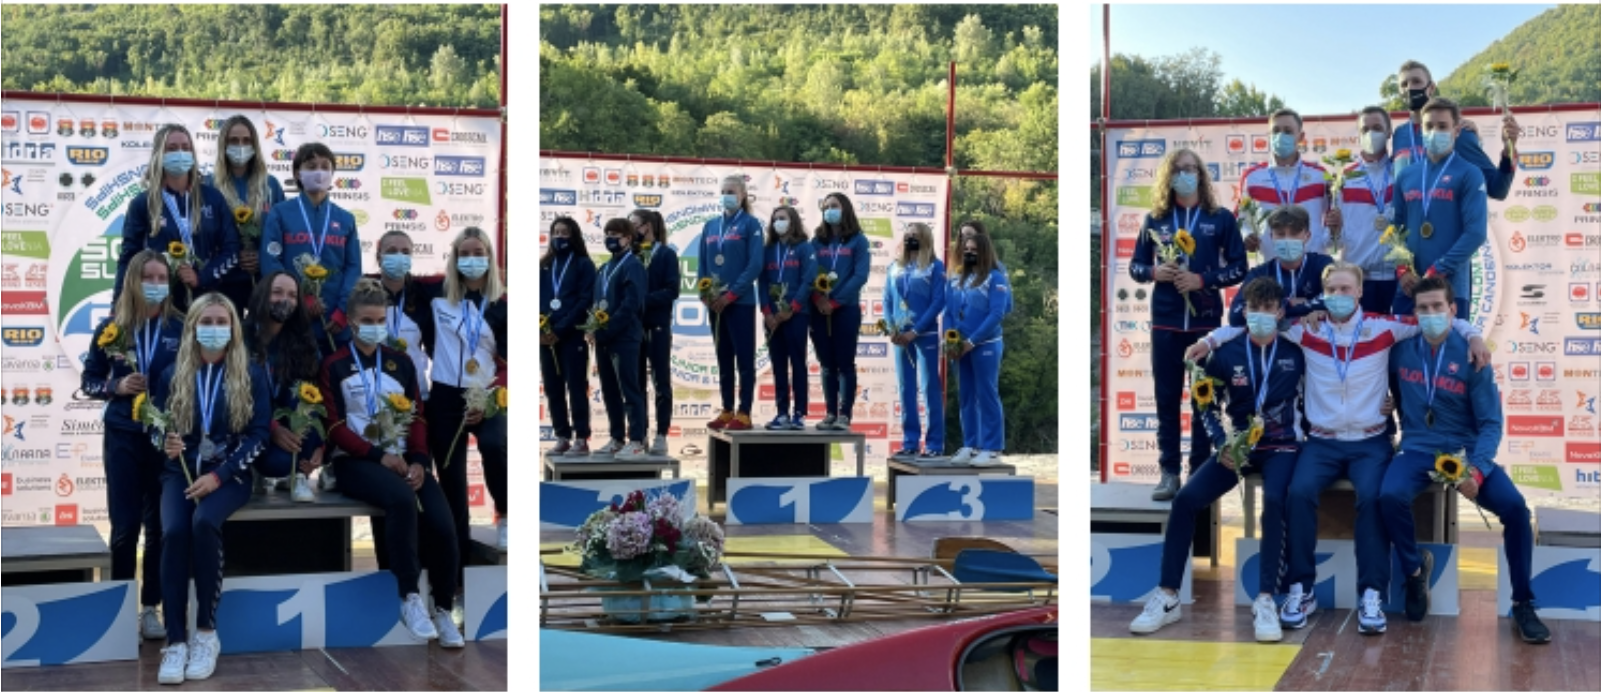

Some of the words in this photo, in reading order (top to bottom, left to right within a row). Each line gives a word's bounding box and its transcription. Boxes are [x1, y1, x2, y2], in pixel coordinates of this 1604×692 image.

[69, 148, 107, 160] RIO
[4, 329, 44, 341] RIO
[779, 480, 811, 524] 1
[945, 477, 986, 523] 3
[276, 572, 326, 650] 1
